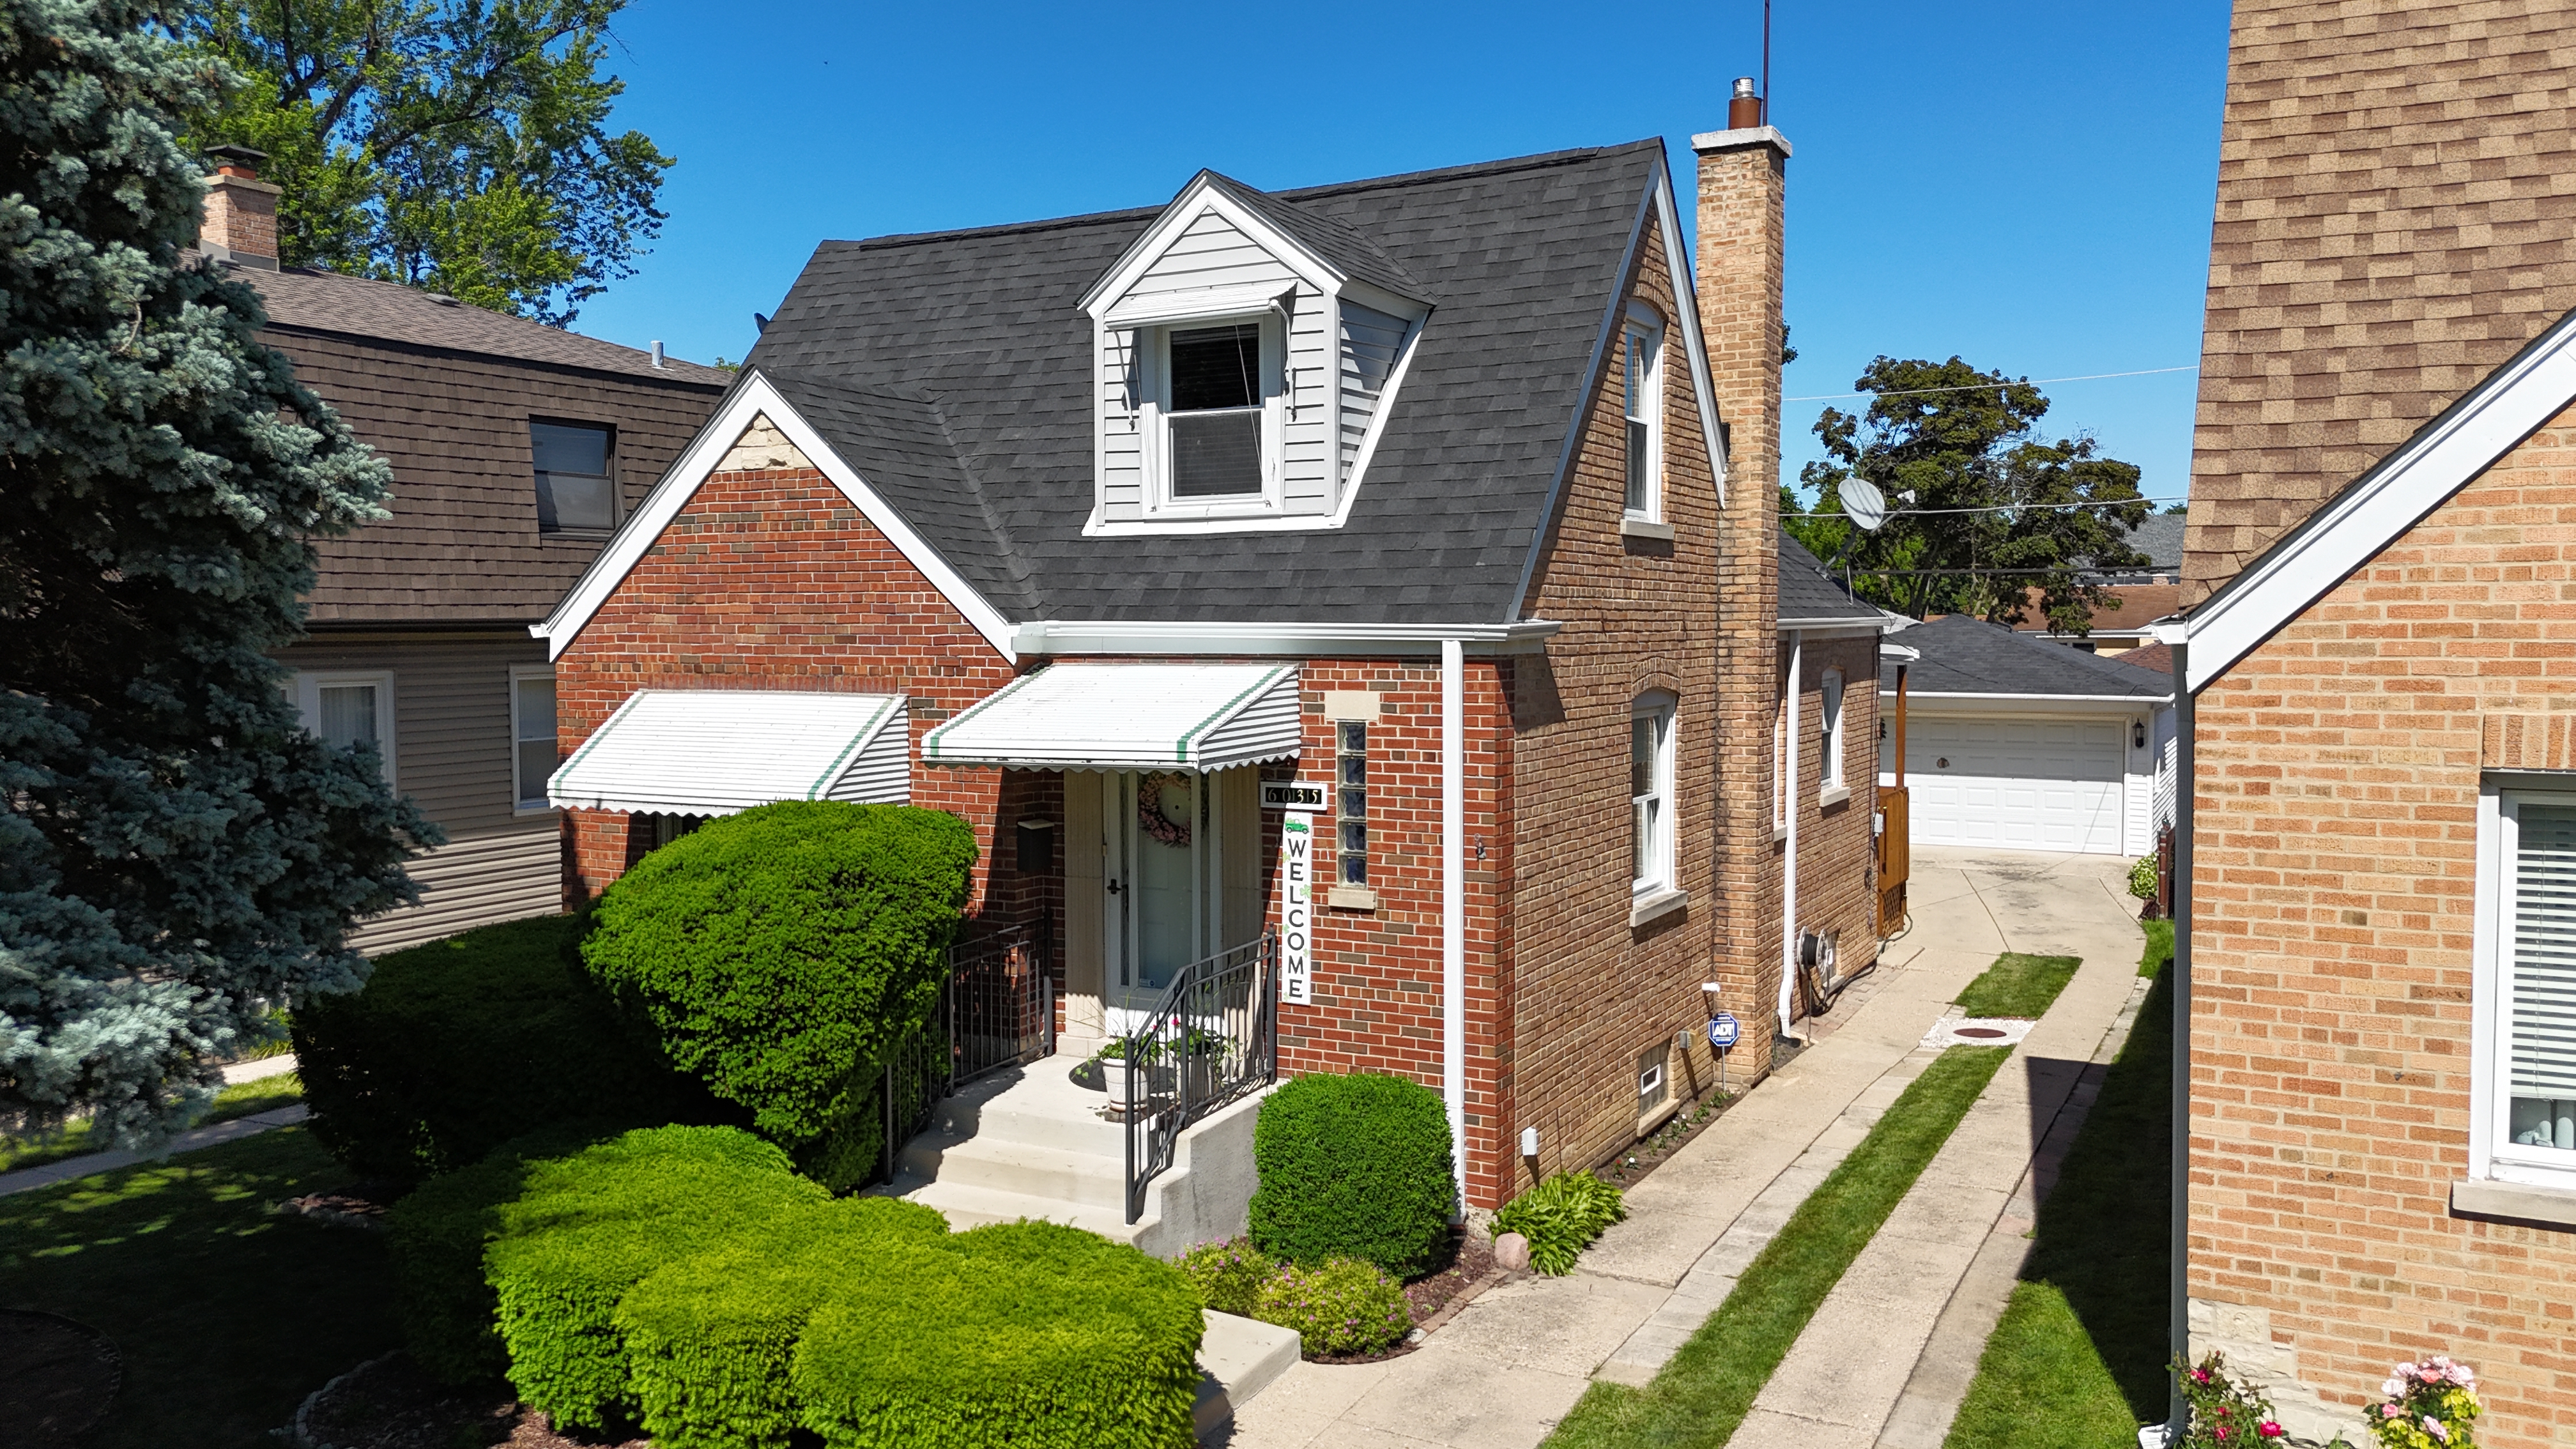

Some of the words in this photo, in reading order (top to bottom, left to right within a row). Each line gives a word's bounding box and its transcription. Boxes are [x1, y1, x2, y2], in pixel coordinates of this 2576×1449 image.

[1268, 788, 1319, 804] 6035
[1287, 838, 1307, 998] WELCOME
[1713, 1023, 1734, 1036] ADT
